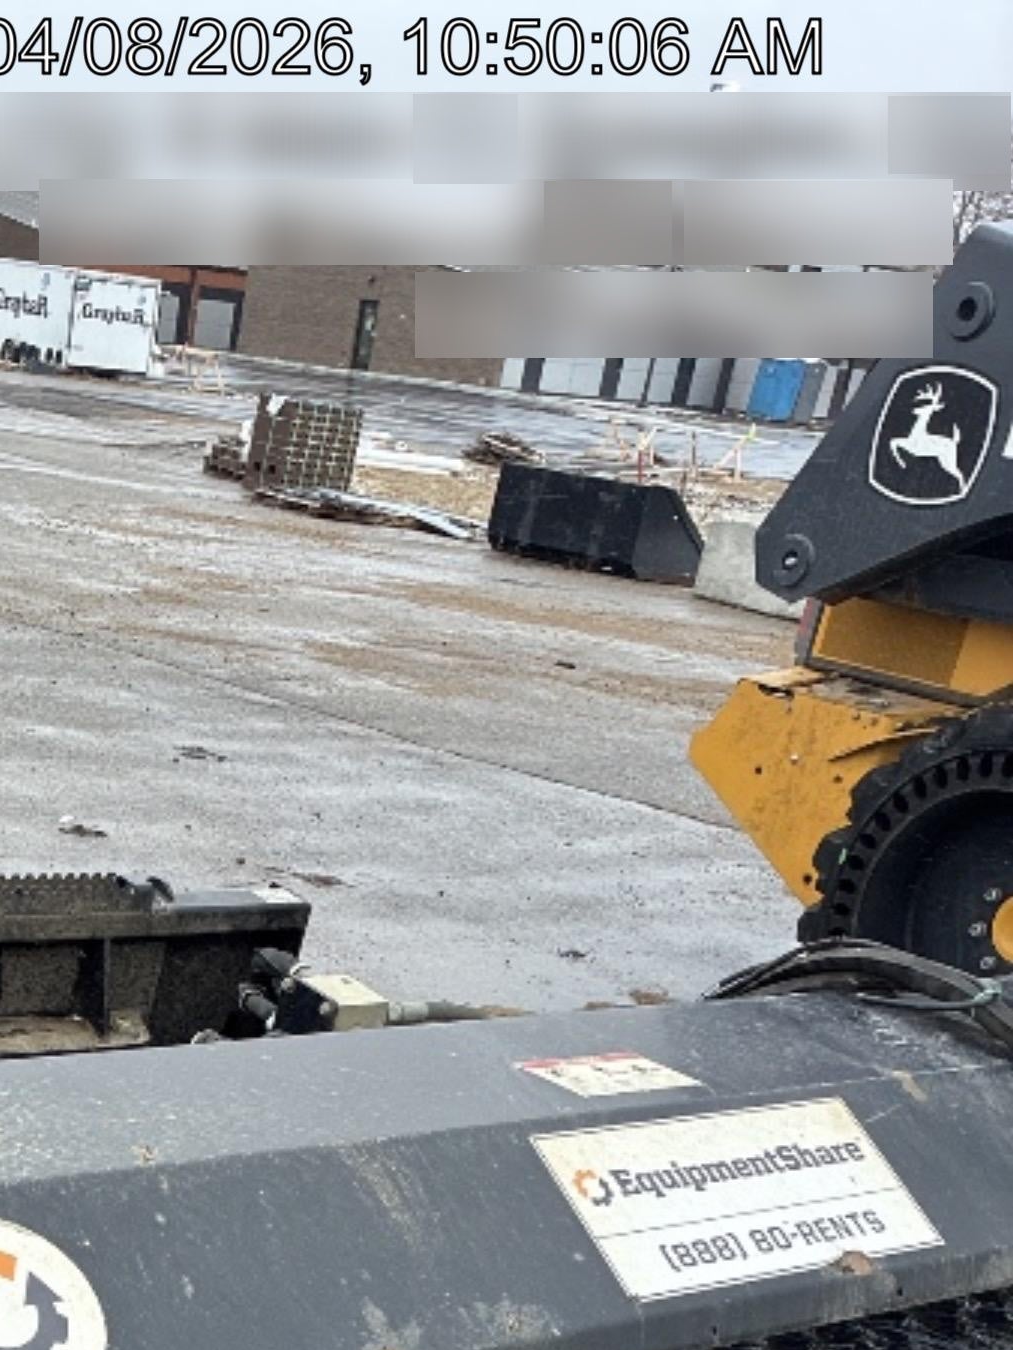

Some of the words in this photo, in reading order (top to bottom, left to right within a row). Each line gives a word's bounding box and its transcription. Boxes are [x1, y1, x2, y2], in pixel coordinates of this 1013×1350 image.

[609, 1142, 865, 1198] EquipmentShare
[659, 1232, 749, 1272] (888)
[748, 1210, 886, 1253] 80-RENTS
